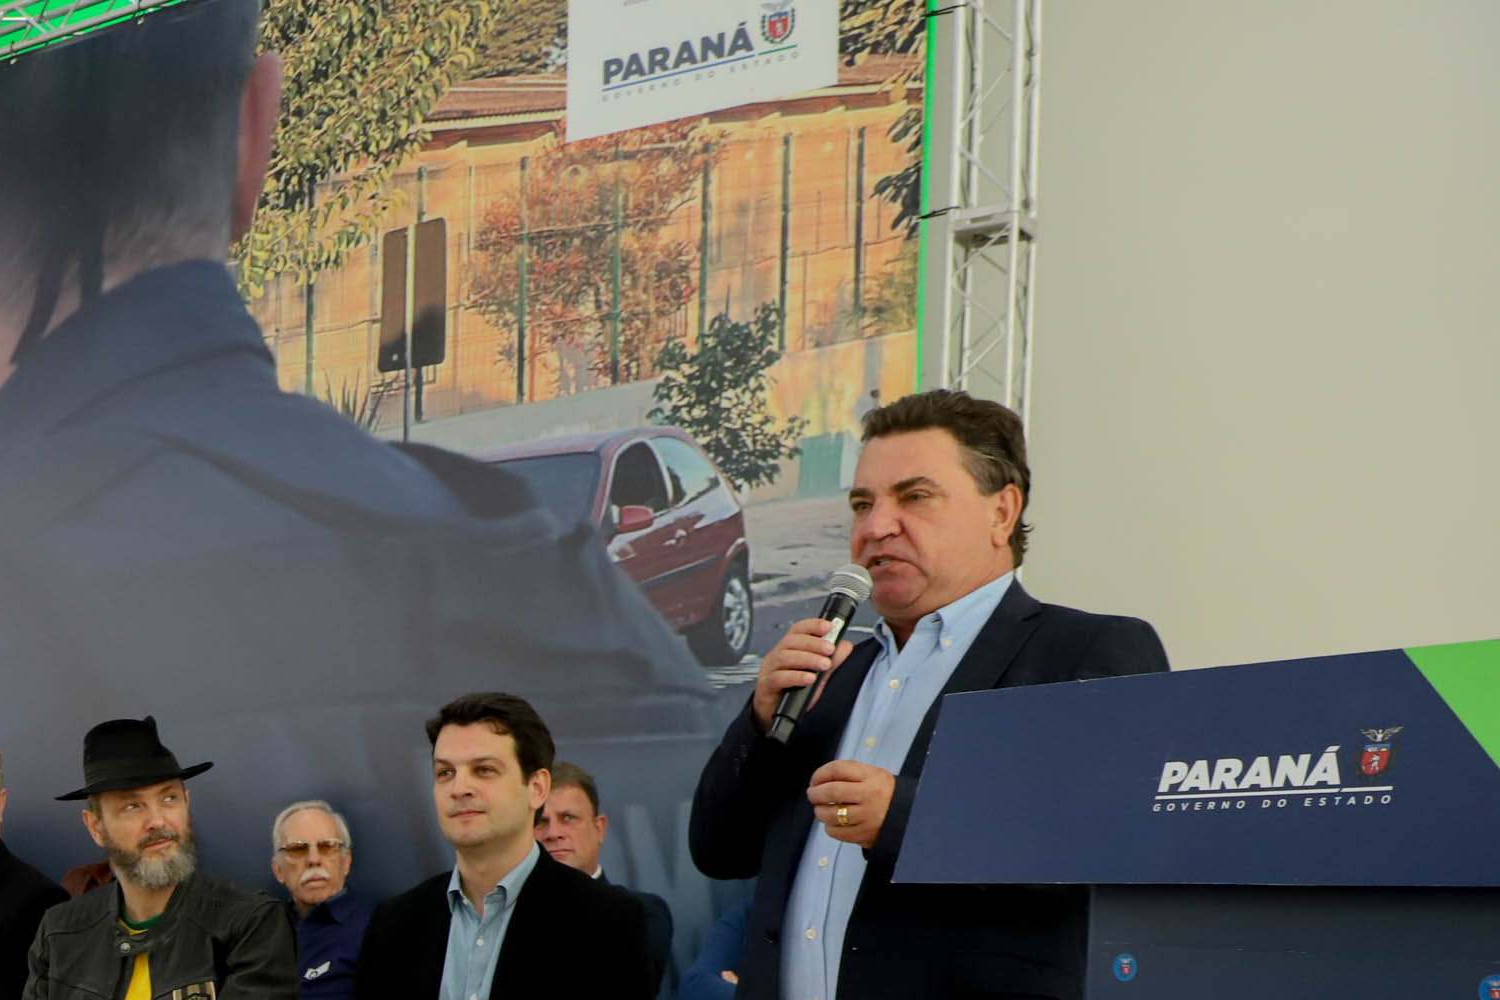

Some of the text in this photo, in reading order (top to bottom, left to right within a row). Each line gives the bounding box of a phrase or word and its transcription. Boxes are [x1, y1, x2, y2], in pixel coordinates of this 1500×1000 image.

[602, 21, 756, 86] PARANÁ
[1156, 745, 1341, 793] PARANÁ
[1152, 795, 1392, 812] GOVERNO DO ESTADO
